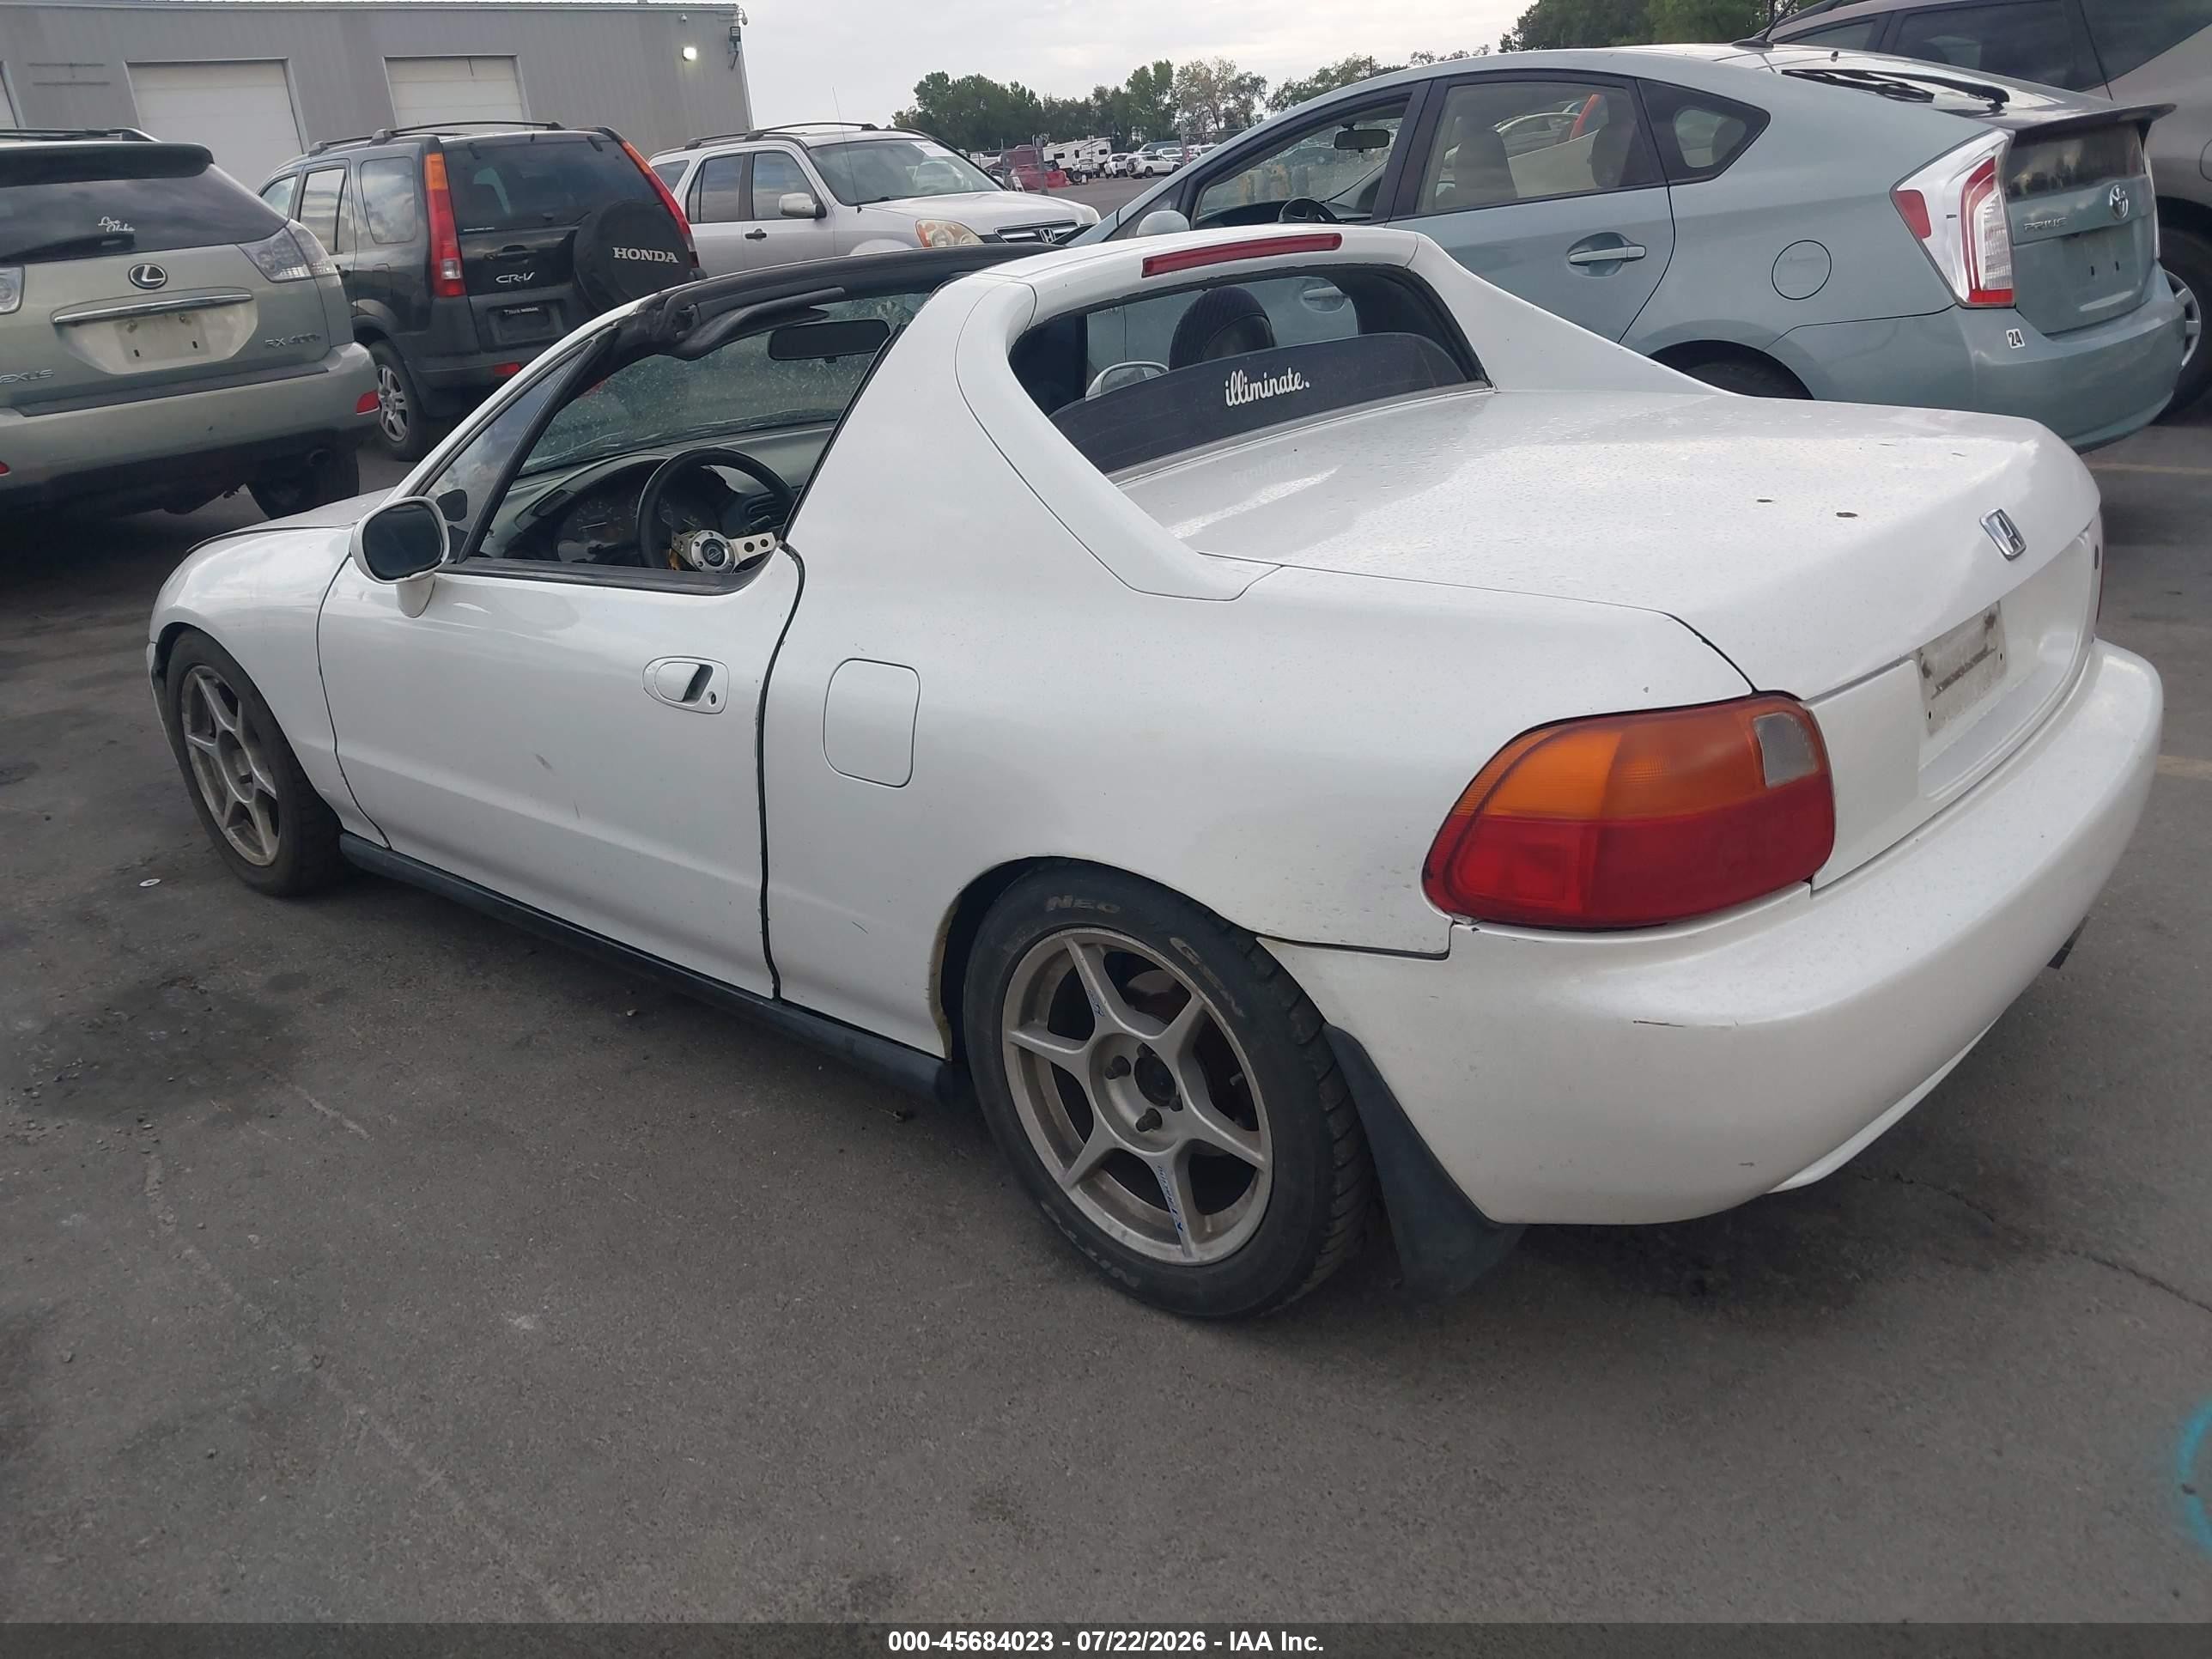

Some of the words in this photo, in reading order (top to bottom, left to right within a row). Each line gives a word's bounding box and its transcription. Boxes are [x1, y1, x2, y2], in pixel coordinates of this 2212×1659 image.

[612, 246, 679, 264] HONDA
[495, 271, 535, 283] CR-V
[264, 337, 286, 347] RX
[2008, 331, 2023, 347] 24
[0, 368, 54, 384] EXUS
[1224, 367, 1310, 407] illiminate.
